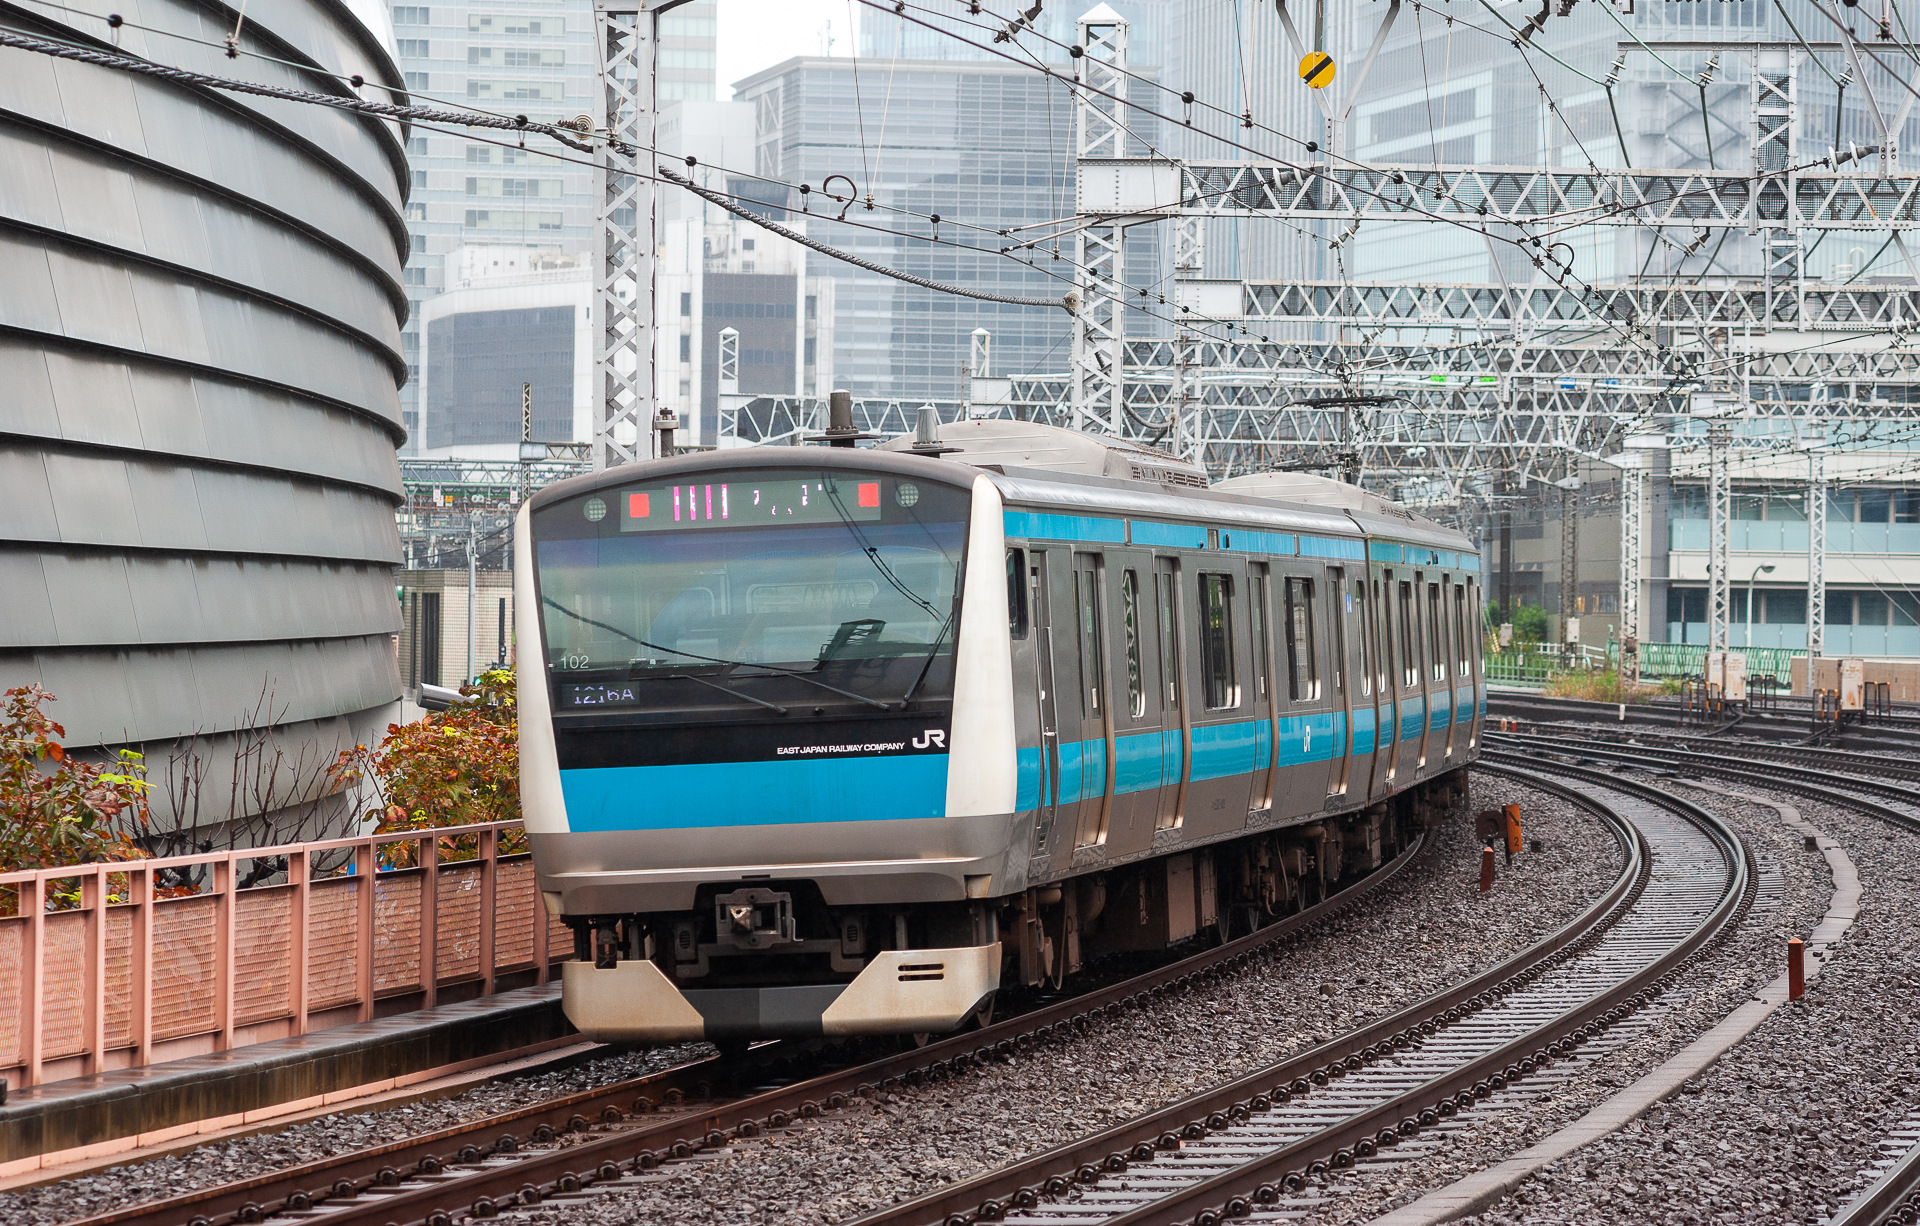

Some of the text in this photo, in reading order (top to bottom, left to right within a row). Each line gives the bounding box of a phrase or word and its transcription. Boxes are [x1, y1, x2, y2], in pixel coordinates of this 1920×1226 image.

[560, 655, 589, 669] 102
[777, 729, 946, 755] EAST JAPAN RAILWAY COMPANY JR
[1303, 725, 1311, 752] JR
[1513, 836, 1519, 847] 2
